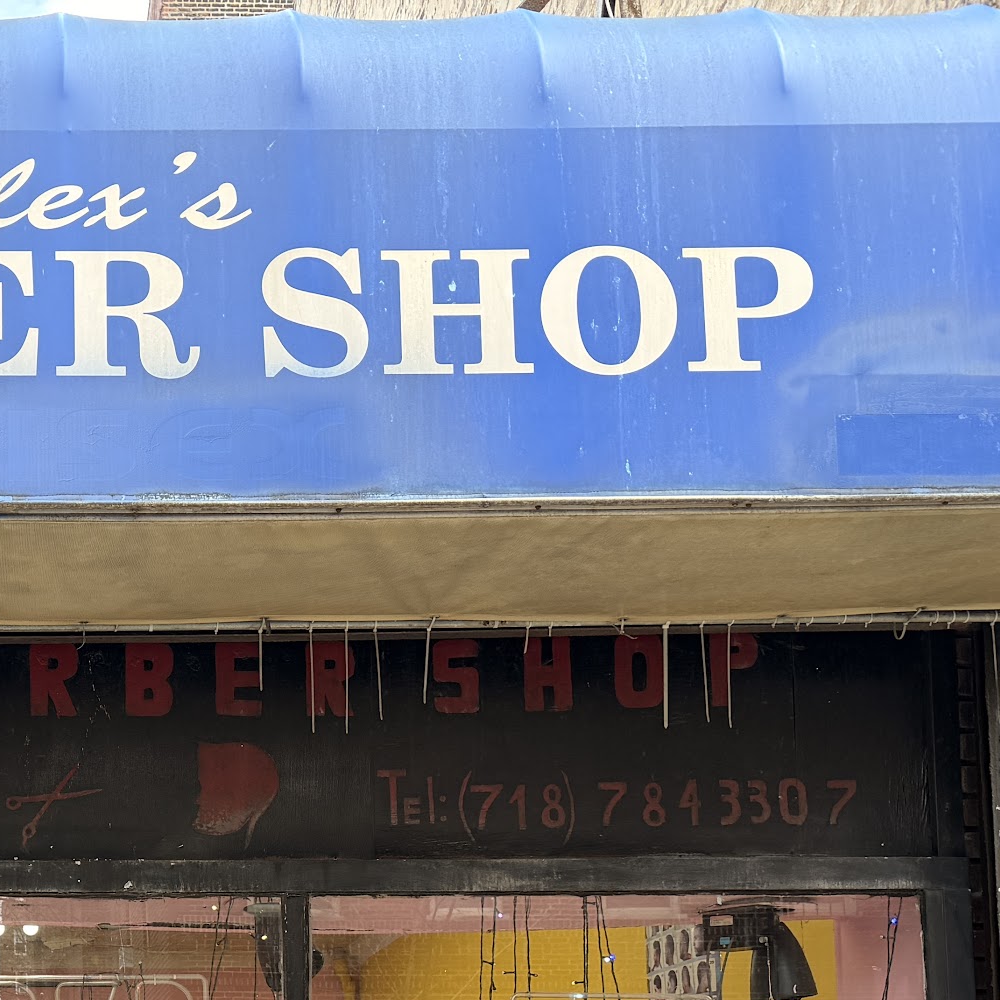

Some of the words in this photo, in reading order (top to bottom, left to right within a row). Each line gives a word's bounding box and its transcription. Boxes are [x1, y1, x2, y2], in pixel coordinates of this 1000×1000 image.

[262, 246, 814, 378] SHOP
[432, 632, 758, 714] SHOP
[458, 770, 576, 845] (718)
